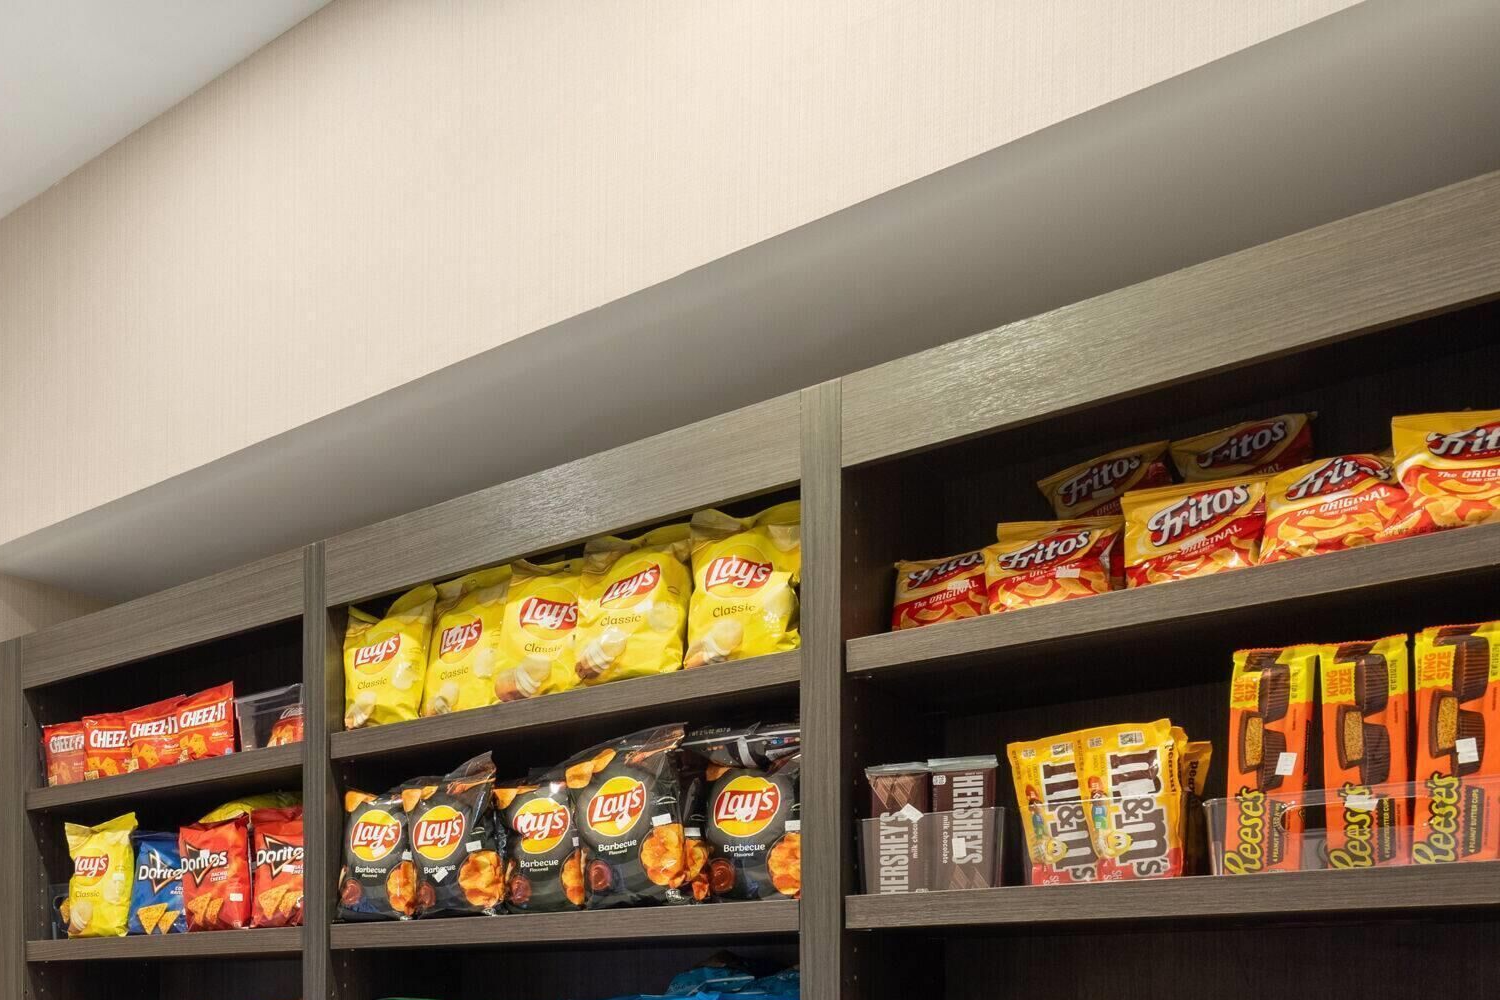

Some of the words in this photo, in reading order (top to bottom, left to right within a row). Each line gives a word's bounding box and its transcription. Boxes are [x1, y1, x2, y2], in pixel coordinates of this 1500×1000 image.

[1199, 421, 1287, 469] Fritos
[1059, 455, 1142, 507] Fritos
[1462, 469, 1500, 480] ORIG
[1297, 508, 1317, 516] The
[1319, 486, 1391, 513] ORIGINAL
[1148, 484, 1249, 547] Fritos
[998, 530, 1091, 570] Fritos
[1180, 524, 1242, 555] ORIGINAL
[601, 568, 657, 602] Lay's
[707, 557, 771, 588] Lay's
[523, 598, 578, 630] Lay's
[600, 614, 642, 627] Classic
[712, 604, 757, 618] Classic
[355, 636, 400, 666] Lay's
[524, 643, 563, 653] Classic
[440, 666, 469, 681] Classic
[1422, 653, 1436, 681] KING
[1438, 651, 1451, 680] SIZE
[357, 677, 388, 690] Classic
[1326, 670, 1338, 697] KING
[1339, 669, 1350, 695] SIZE
[180, 701, 227, 729] CHEEZ-IT
[591, 787, 643, 822] Lay's
[717, 789, 776, 823] Lay's
[1413, 772, 1461, 865] Reese's
[353, 822, 397, 849] Lay's
[415, 817, 461, 848] Lay's
[1224, 785, 1268, 875] Reese's
[256, 846, 304, 867] Dorito
[598, 839, 638, 852] Barbecue
[723, 843, 766, 853] Barbecue
[180, 851, 229, 873] Doritos
[355, 866, 387, 874] Barbecue
[520, 859, 559, 868] Barbecue
[75, 889, 101, 899] Classic
